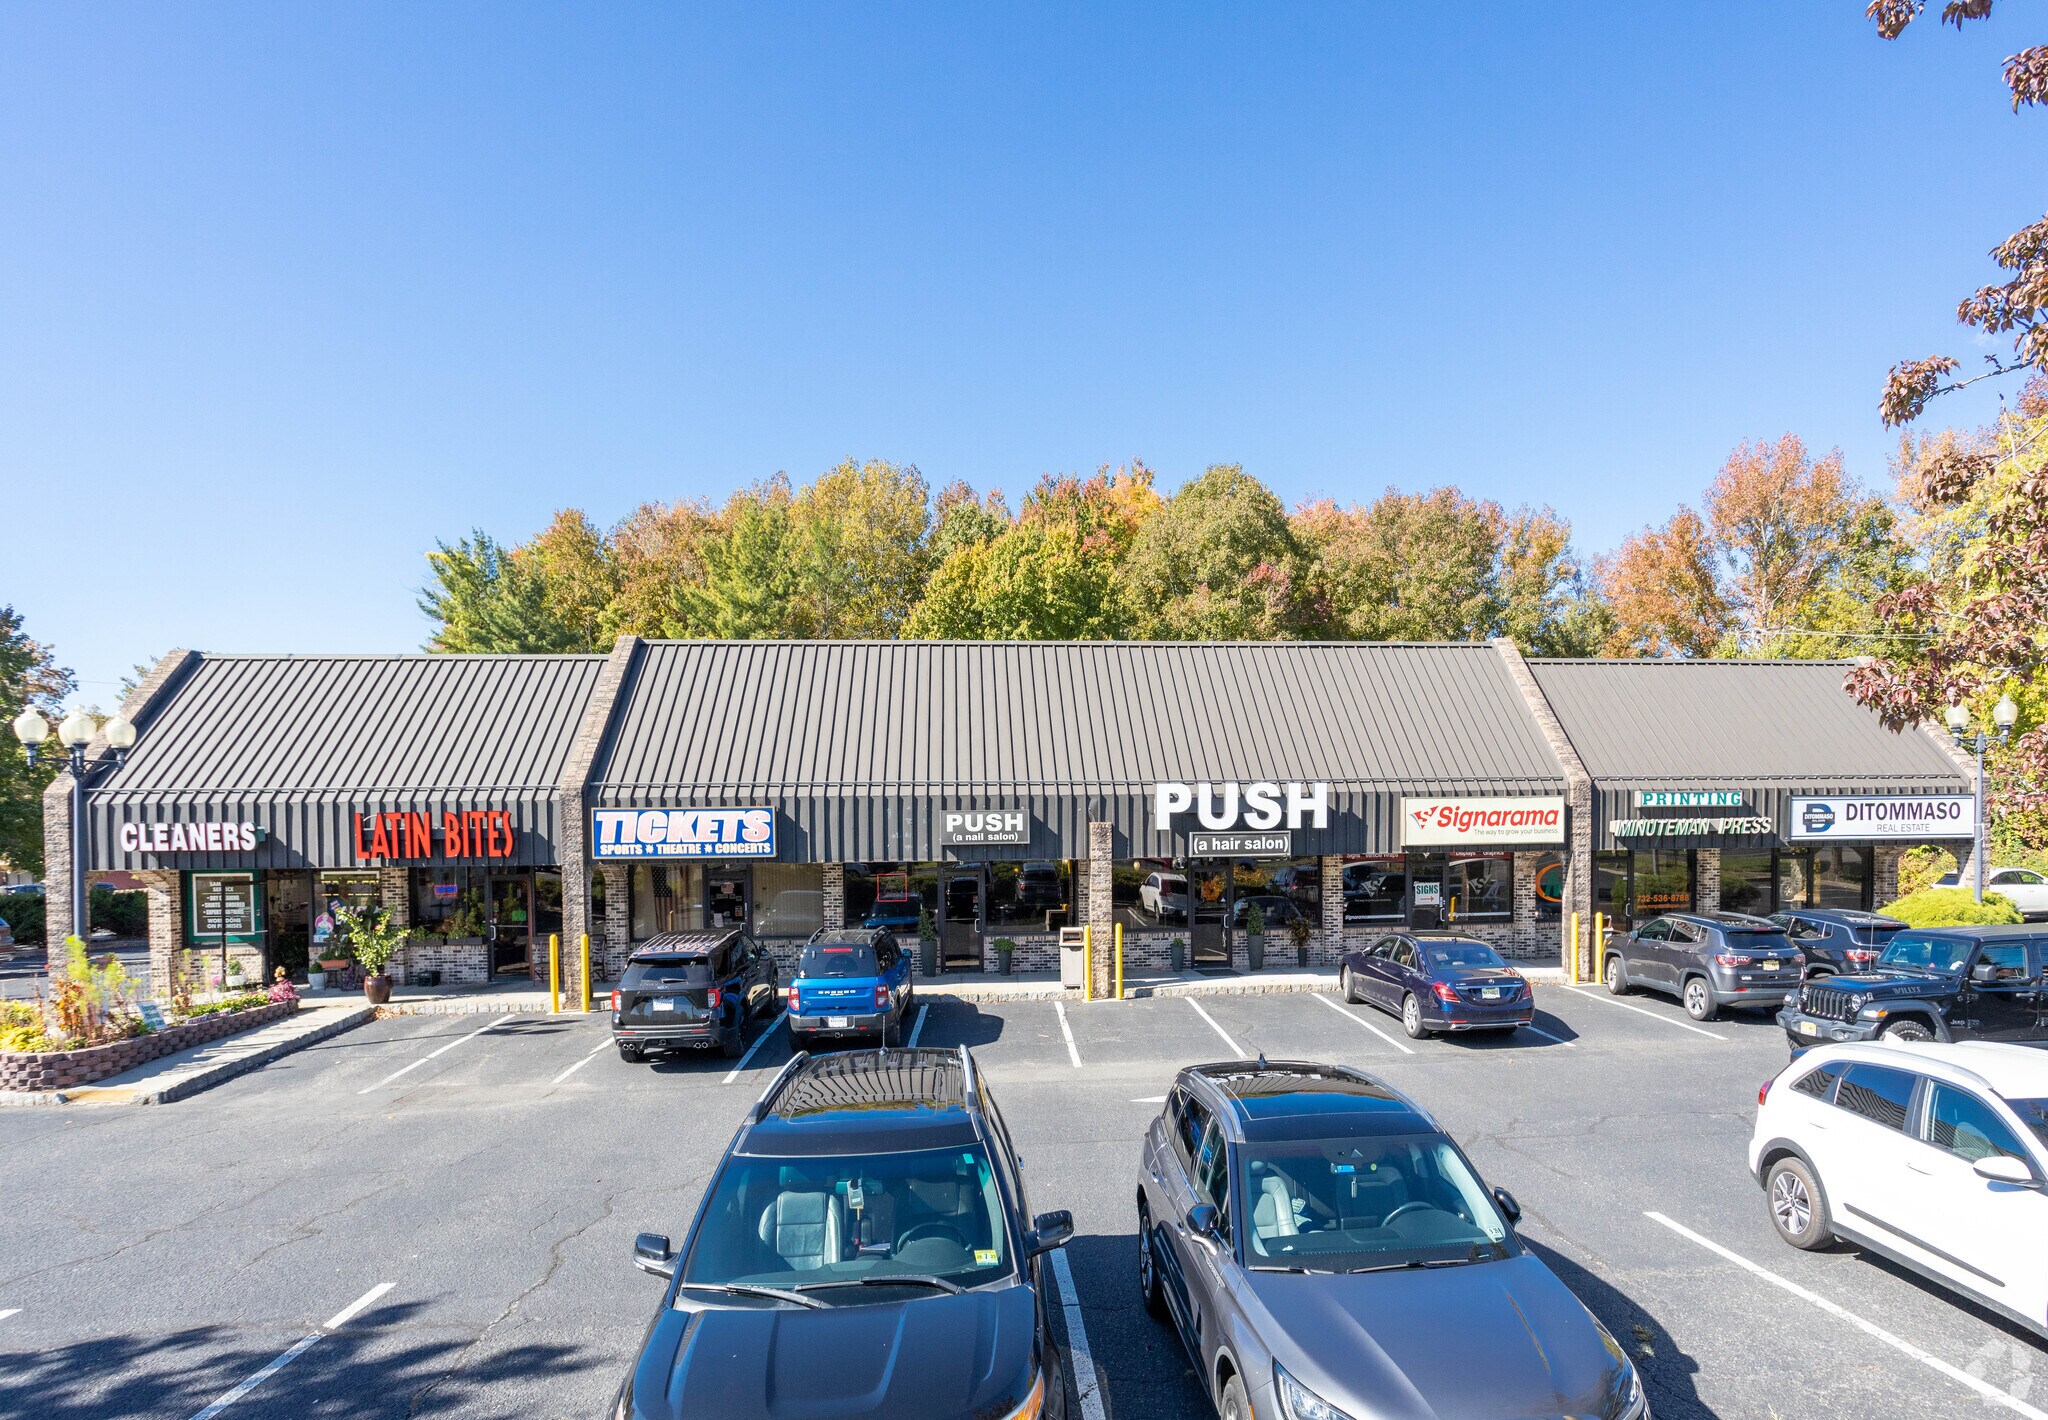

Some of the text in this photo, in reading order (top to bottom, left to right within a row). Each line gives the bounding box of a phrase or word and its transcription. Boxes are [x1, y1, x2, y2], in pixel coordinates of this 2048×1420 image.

[1156, 782, 1328, 830] PUSH
[1642, 792, 1741, 806] PRINTING
[1437, 805, 1559, 833] Signarama
[1846, 802, 1961, 821] DITOMMASO
[596, 810, 771, 844] TICKETS
[946, 813, 1024, 832] PUSH
[1614, 817, 1772, 837] MINUTEMAN PRESS
[1876, 823, 1930, 833] REAL ESTATE
[120, 821, 257, 852] CLEANERS
[354, 811, 514, 859] LATIN BITES
[952, 832, 1018, 843] (a nail salon)
[1193, 836, 1289, 853] (a hair salon)
[600, 842, 771, 855] SPORTS THEATRE CONCERTS
[1416, 884, 1439, 895] SIGNS
